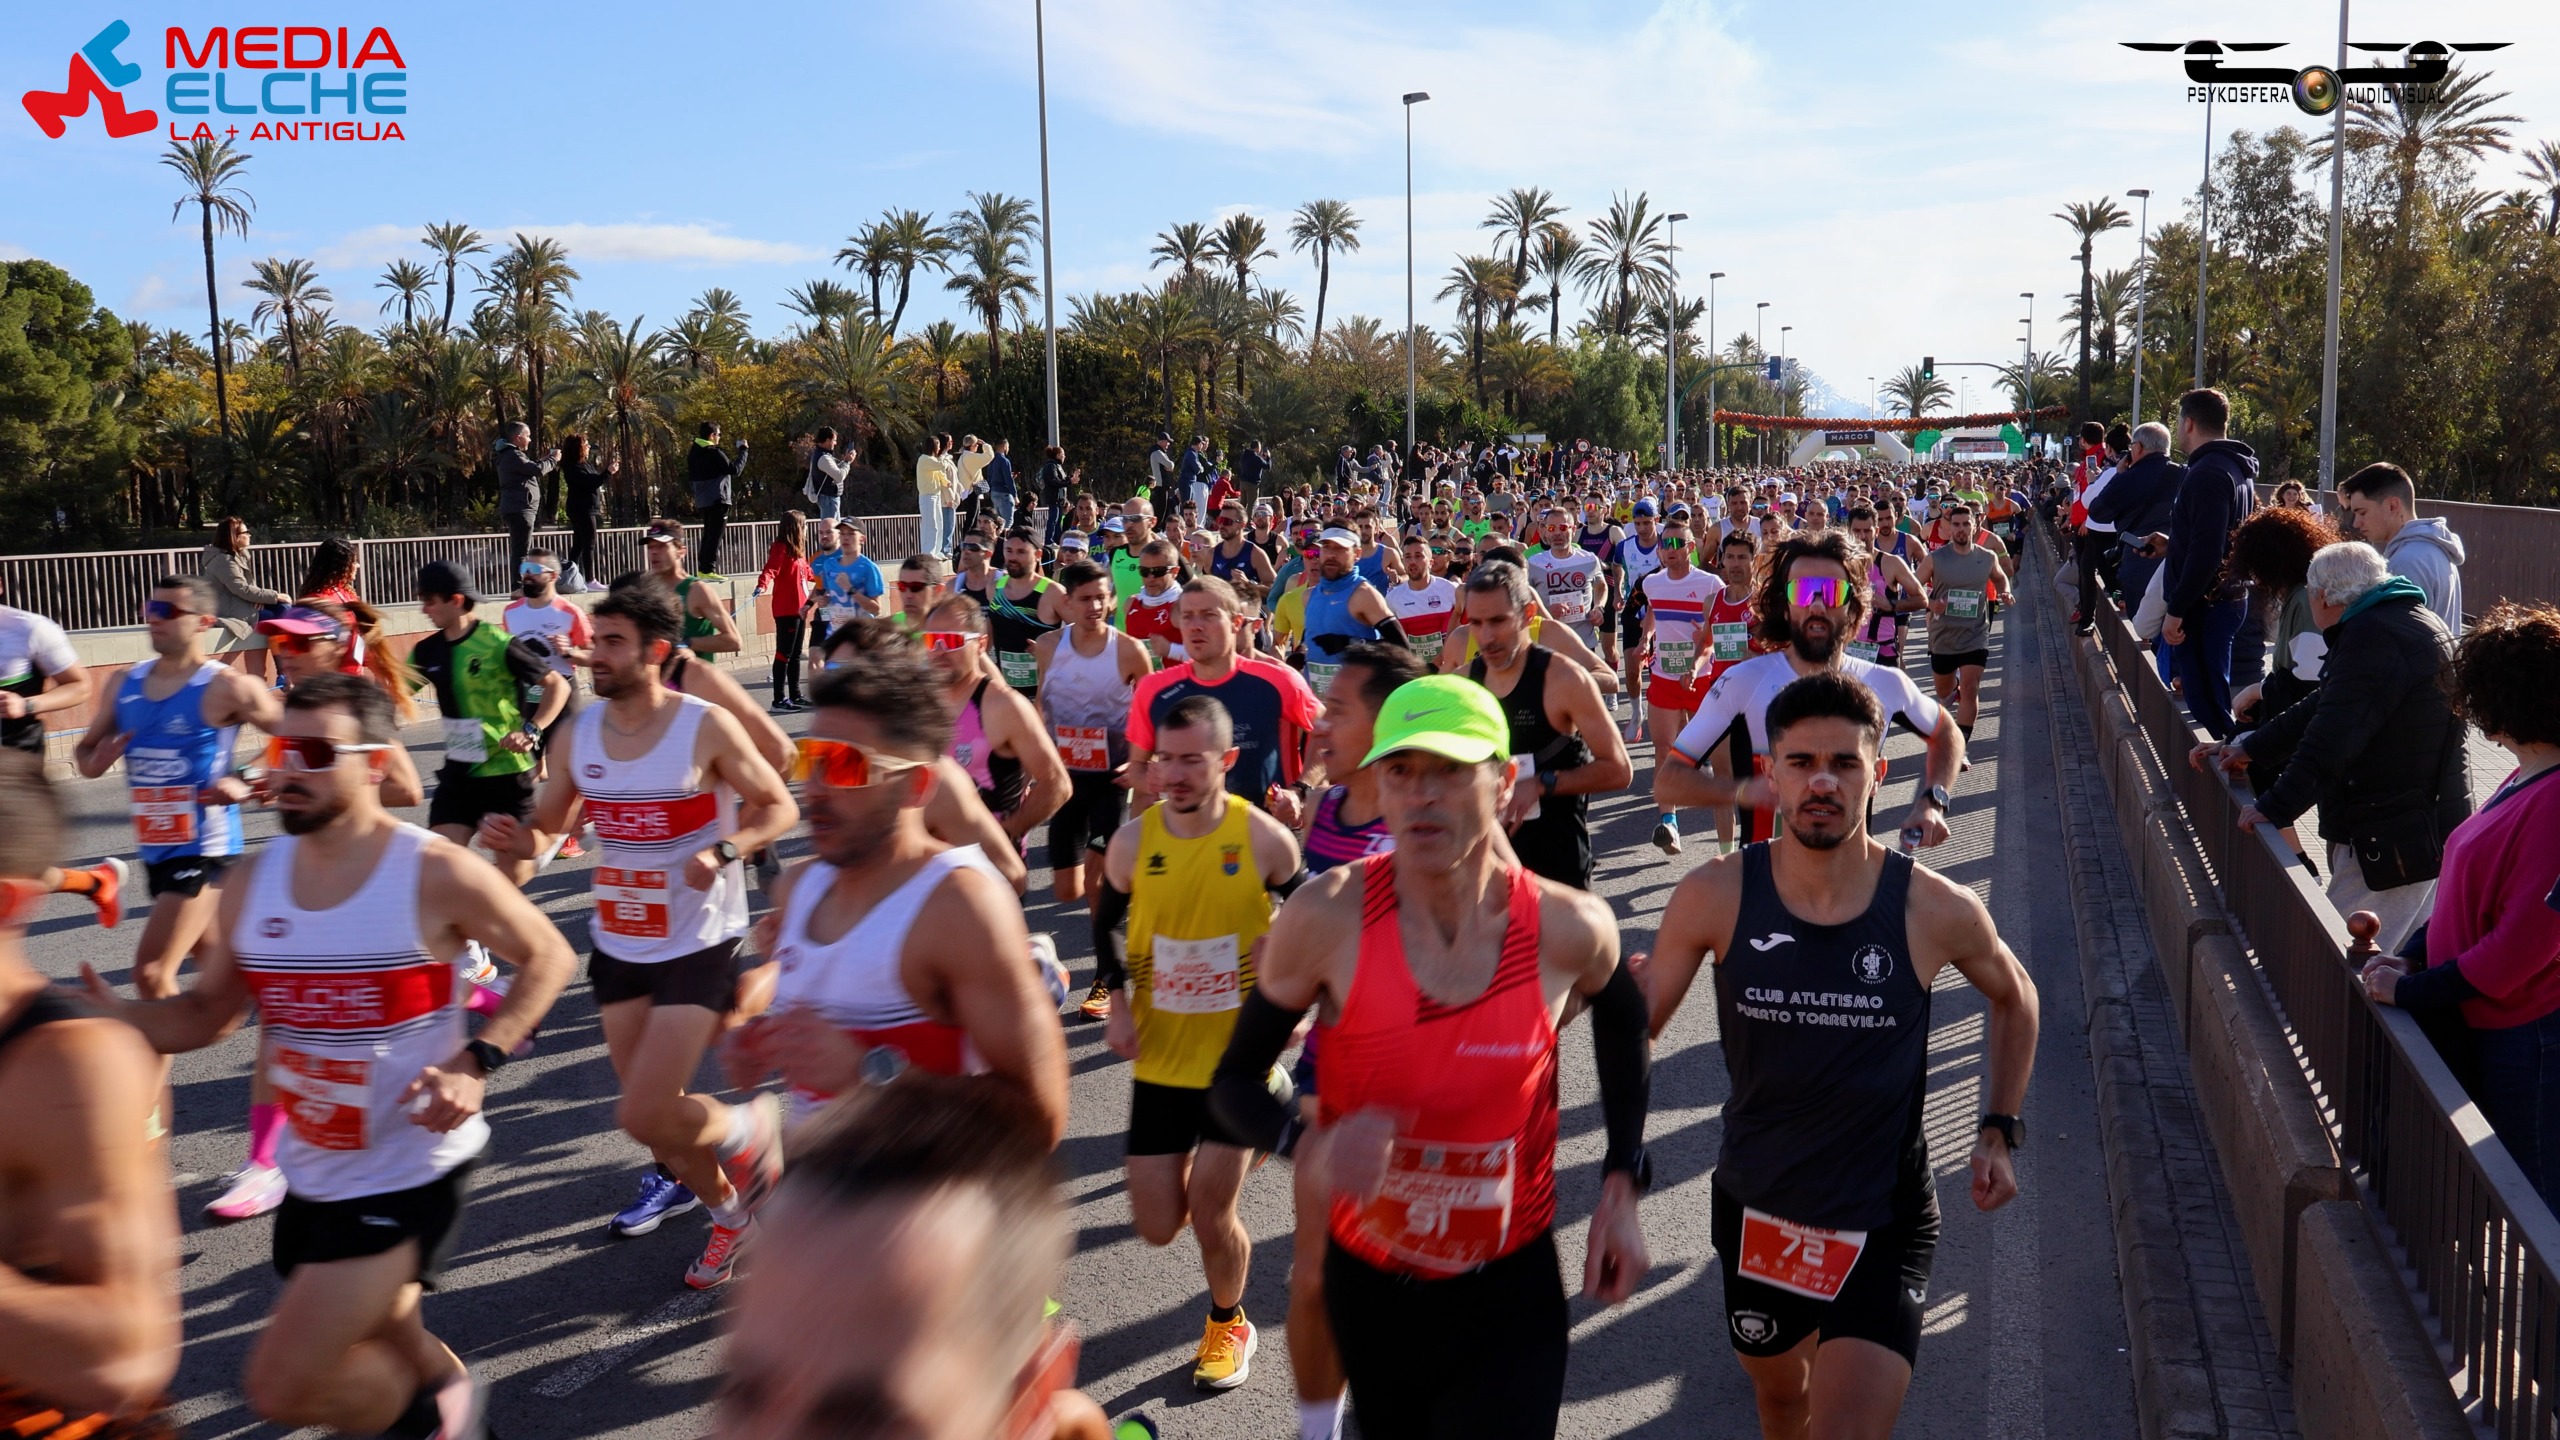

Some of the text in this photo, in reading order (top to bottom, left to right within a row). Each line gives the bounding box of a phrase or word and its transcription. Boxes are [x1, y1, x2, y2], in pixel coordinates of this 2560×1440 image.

[1831, 433, 1869, 441] MARCOS
[1721, 642, 1738, 652] 218
[1669, 658, 1687, 667] 261
[1006, 669, 1031, 679] 422
[1745, 987, 1884, 1009] CLUB ATLETISMO
[1736, 1002, 1897, 1028] PUERTO TORREVIEJA
[1780, 1226, 1825, 1268] 72
